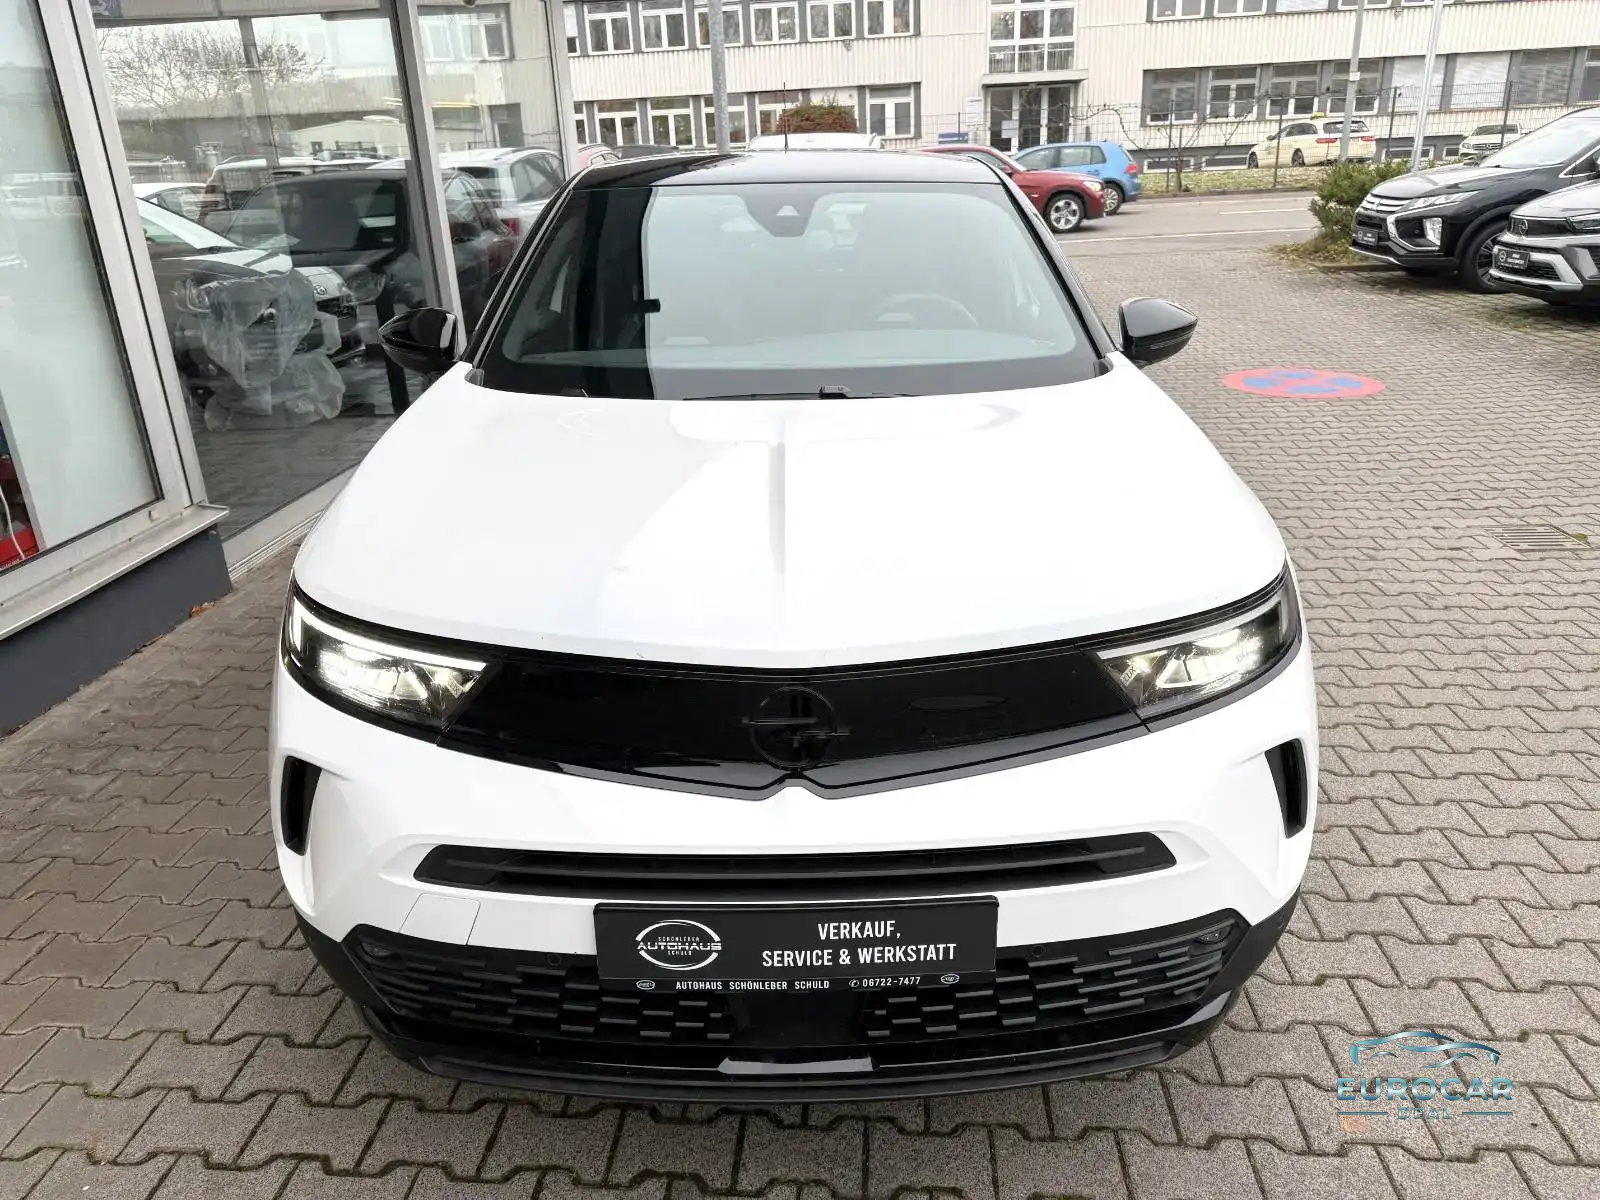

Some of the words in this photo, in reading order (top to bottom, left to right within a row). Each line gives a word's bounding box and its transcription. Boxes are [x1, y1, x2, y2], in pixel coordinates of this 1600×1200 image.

[818, 920, 901, 940] VERKAUF,
[637, 942, 722, 951] AUTOHAUS
[762, 950, 833, 967] SERVICE
[838, 948, 852, 965] &
[857, 943, 957, 964] WERKSTATT
[675, 981, 723, 990] AUTOHAUS
[729, 980, 788, 990] SCHÖNLEBER
[795, 980, 830, 990] SCHULD
[862, 976, 921, 988] 06722-7477
